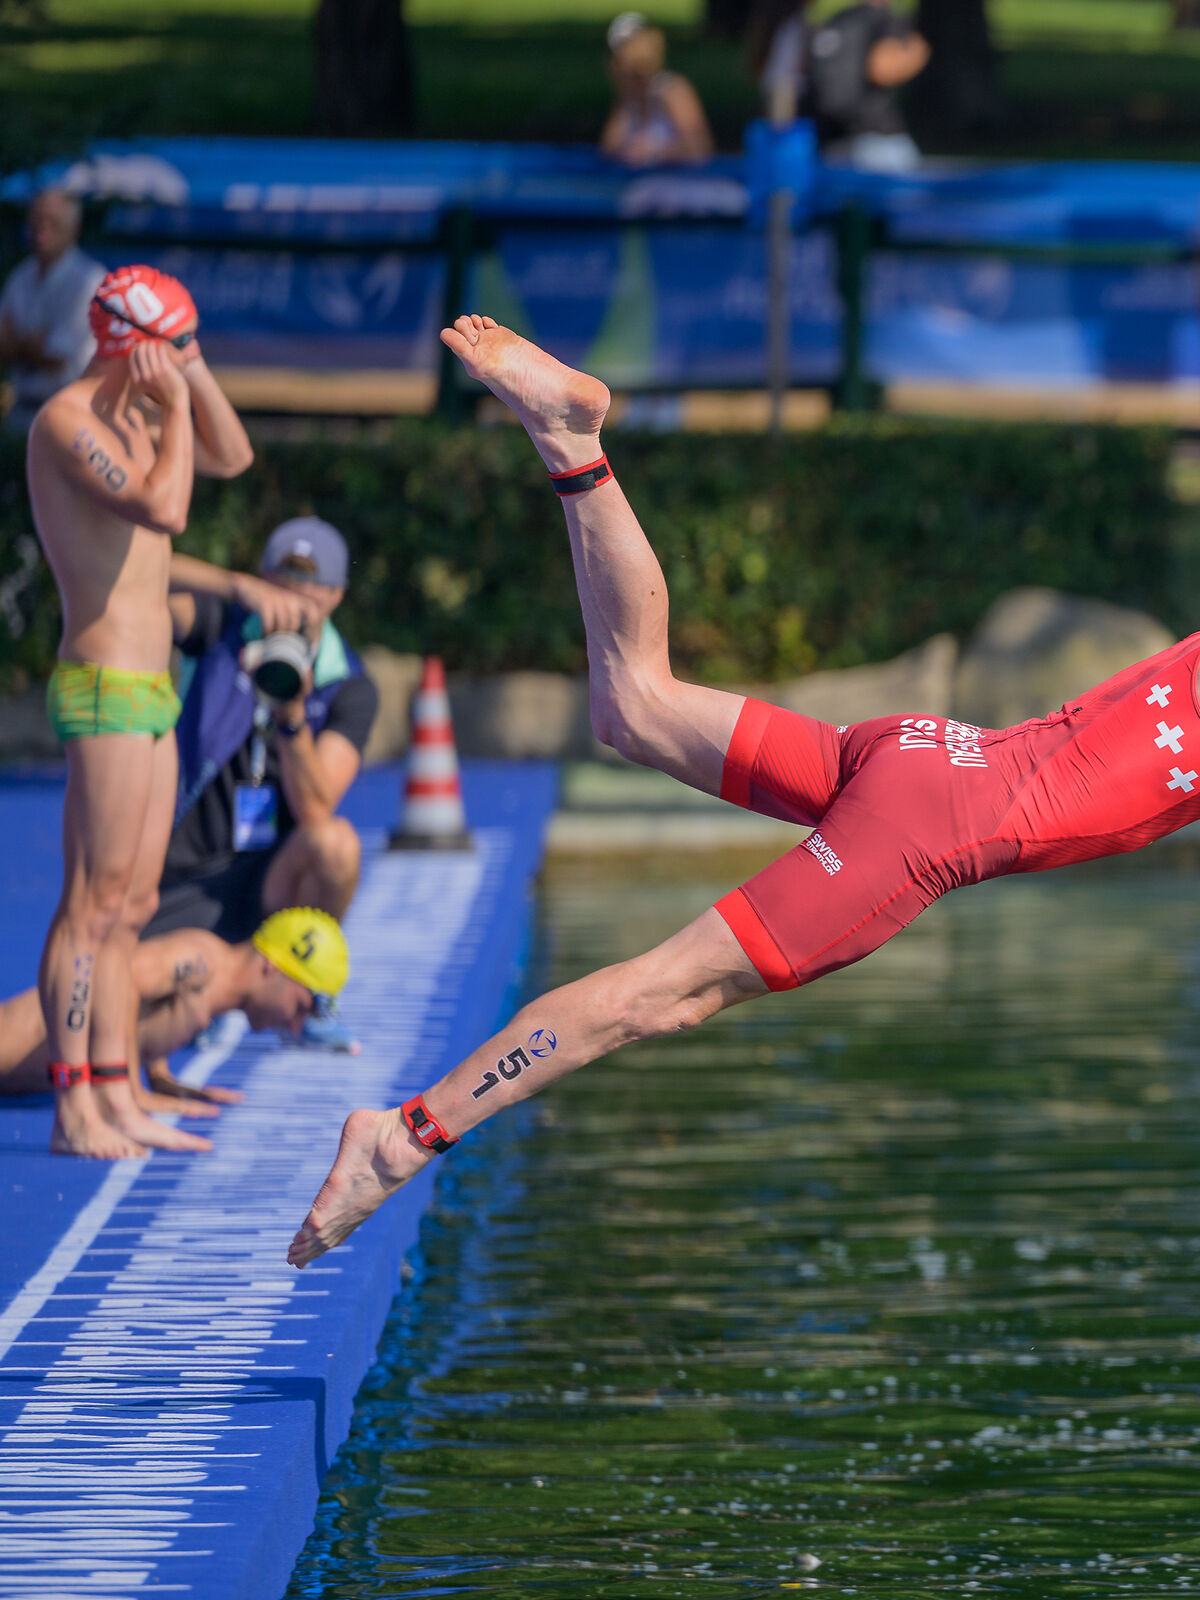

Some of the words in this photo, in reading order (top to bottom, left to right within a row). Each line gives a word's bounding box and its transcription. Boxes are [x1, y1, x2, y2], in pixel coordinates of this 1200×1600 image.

[899, 718, 938, 751] SUI
[811, 833, 844, 872] SWISS
[471, 1045, 533, 1100] 51
